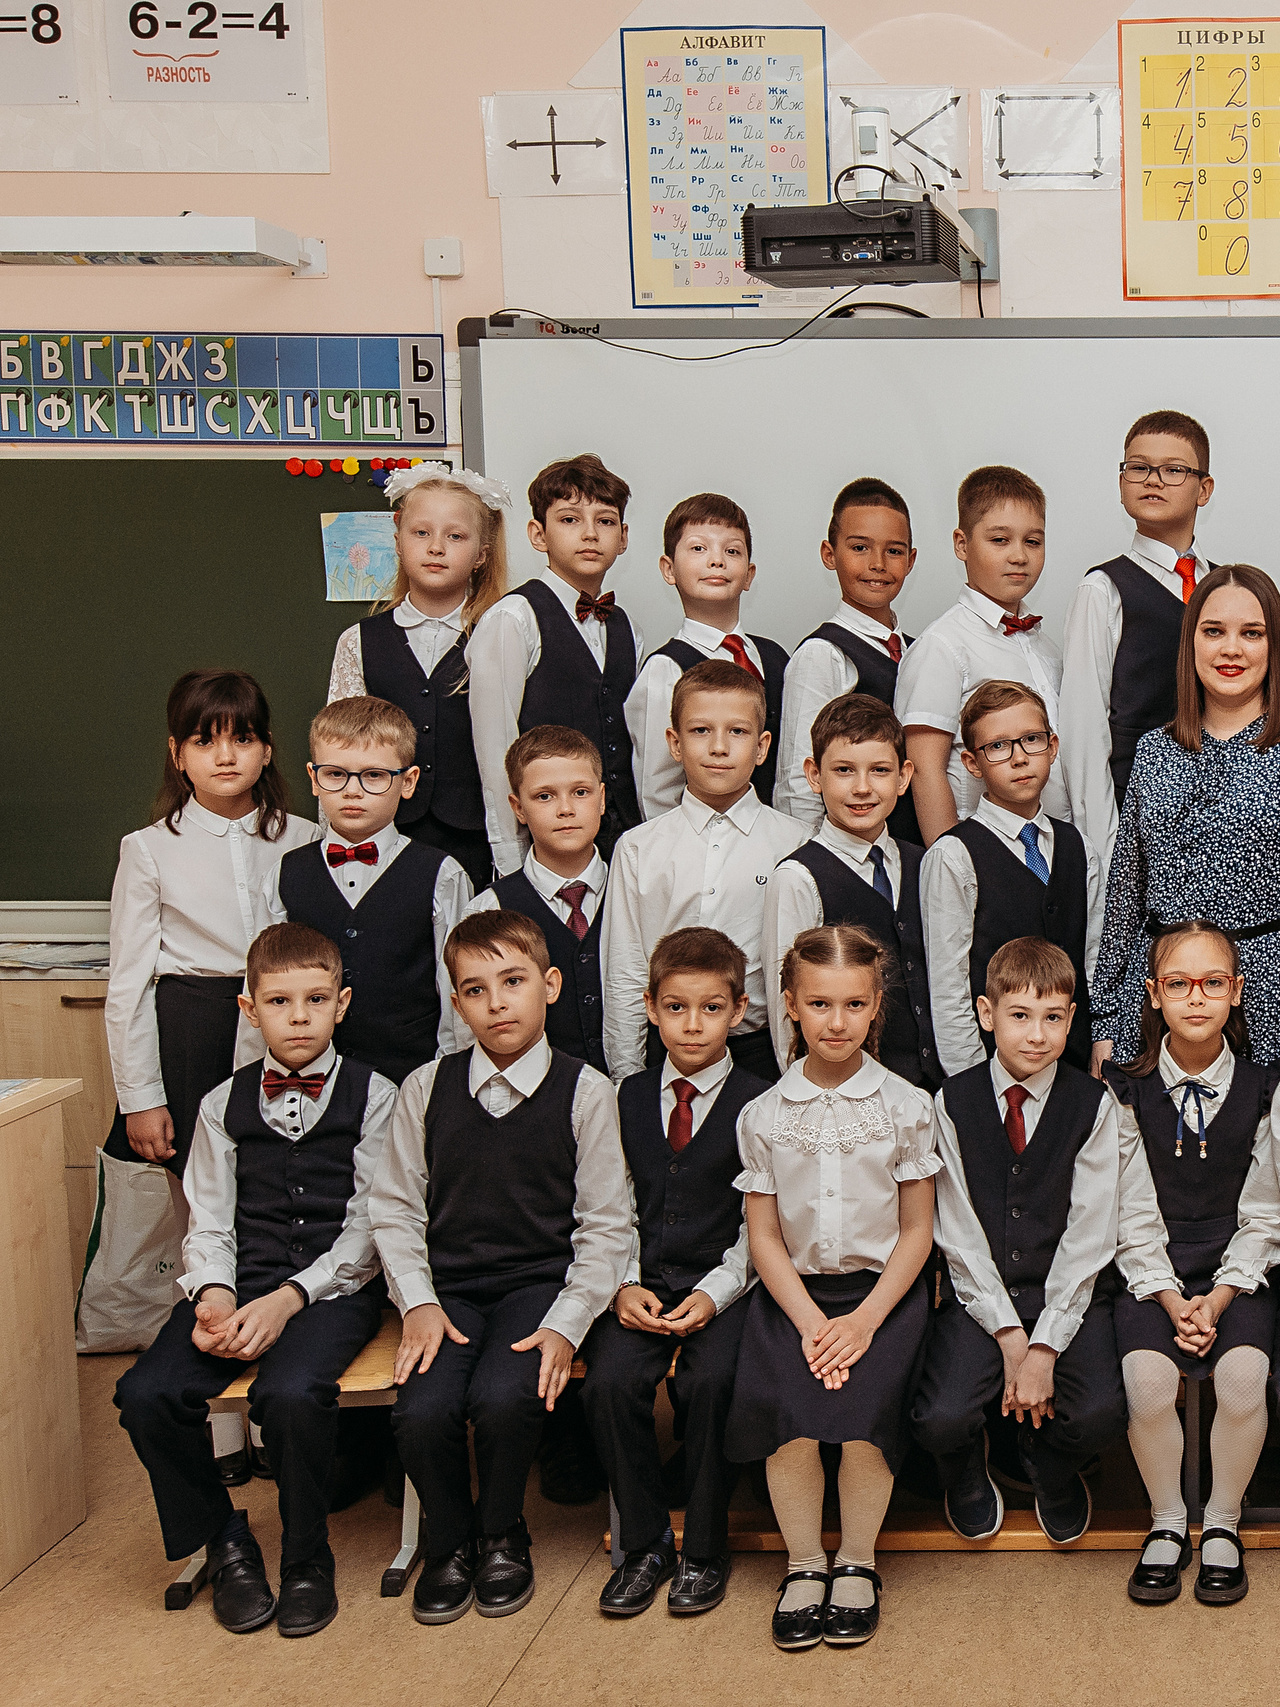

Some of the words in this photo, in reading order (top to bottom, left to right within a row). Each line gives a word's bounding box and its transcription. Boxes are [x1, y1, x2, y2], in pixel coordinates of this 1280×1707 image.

[129, 1, 290, 39] 6-2=4
[680, 35, 766, 49] АЛФАВИТ
[1177, 29, 1265, 47] ЦИФРЫ
[1142, 57, 1148, 72] 1
[1196, 56, 1205, 71] 2
[1252, 55, 1260, 71] 3
[147, 66, 210, 83] РАЗНОСТЬ
[1175, 68, 1192, 108] 1
[1225, 68, 1247, 108] 2
[1142, 115, 1151, 129] 4
[1198, 113, 1206, 128] 5
[1252, 112, 1261, 127] 6
[1173, 125, 1193, 164] 4
[1226, 123, 1248, 163] 5
[1143, 171, 1152, 186] 7
[1198, 170, 1207, 184] 8
[1253, 169, 1262, 184] 9
[1174, 181, 1194, 221] 7
[1225, 180, 1248, 219] 8
[1199, 226, 1208, 240] 0
[1225, 236, 1249, 275] 0
[0, 340, 24, 380] Б
[41, 341, 64, 380] В
[83, 341, 103, 381] Г
[117, 342, 150, 385] Д
[157, 342, 193, 381] Ж
[37, 393, 72, 432] Ф
[83, 393, 111, 433] К
[124, 393, 149, 433] Т
[160, 394, 196, 434] Ш
[286, 395, 317, 439] Ц
[327, 397, 352, 435] Ч
[363, 397, 401, 440] Щ
[407, 398, 436, 435] Ъ
